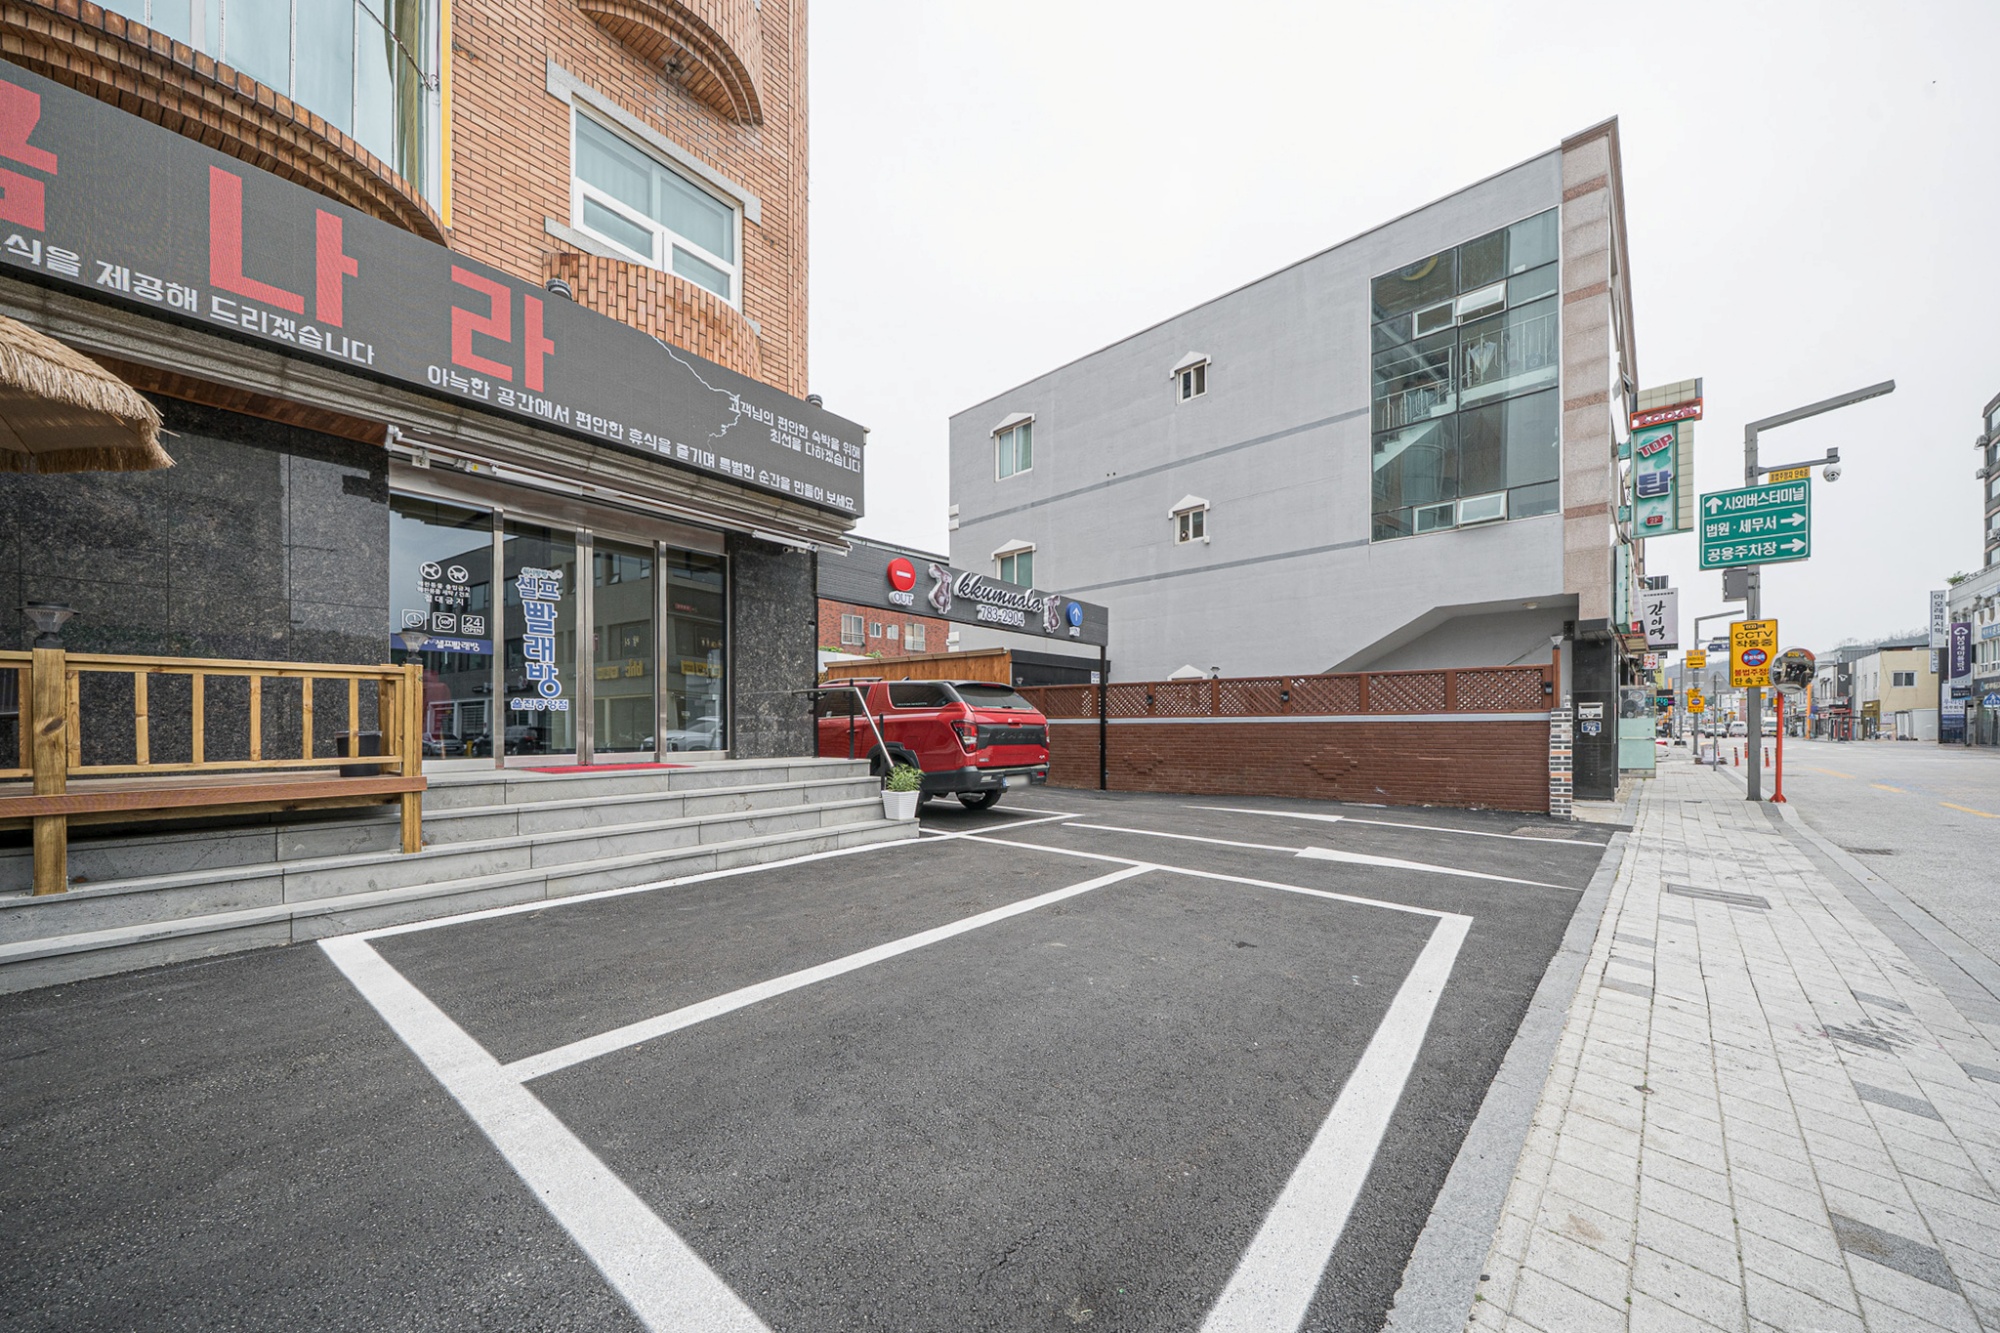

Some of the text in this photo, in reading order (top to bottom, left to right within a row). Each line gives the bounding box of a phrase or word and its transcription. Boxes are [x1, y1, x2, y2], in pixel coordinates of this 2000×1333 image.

[0, 233, 375, 365] 식을 제공해 드리겠습니다
[427, 364, 857, 512] 아늑한 공간에서 편안한 휴식을 즐기며 특별한 순간을 만들어 보세요.
[728, 394, 861, 460] 고객님의 편안한 숙박을 위해
[770, 428, 861, 474] 최선을 다하겠습니다
[1637, 433, 1674, 458] TOP
[1637, 469, 1673, 499] 탑
[1723, 486, 1804, 511] 시외버스터미널
[1706, 521, 1730, 538] 법원
[1738, 515, 1777, 533] 세무서
[1707, 541, 1777, 562] 공용주차장
[890, 592, 914, 606] OUT
[466, 617, 481, 626] 24
[979, 605, 1025, 627] 783-2904
[1646, 600, 1666, 640] 간이역
[1734, 630, 1774, 640] CCTV
[1735, 638, 1774, 648] 작동중
[1734, 668, 1770, 677] 불법주정
[510, 697, 569, 711] 울진중앙점
